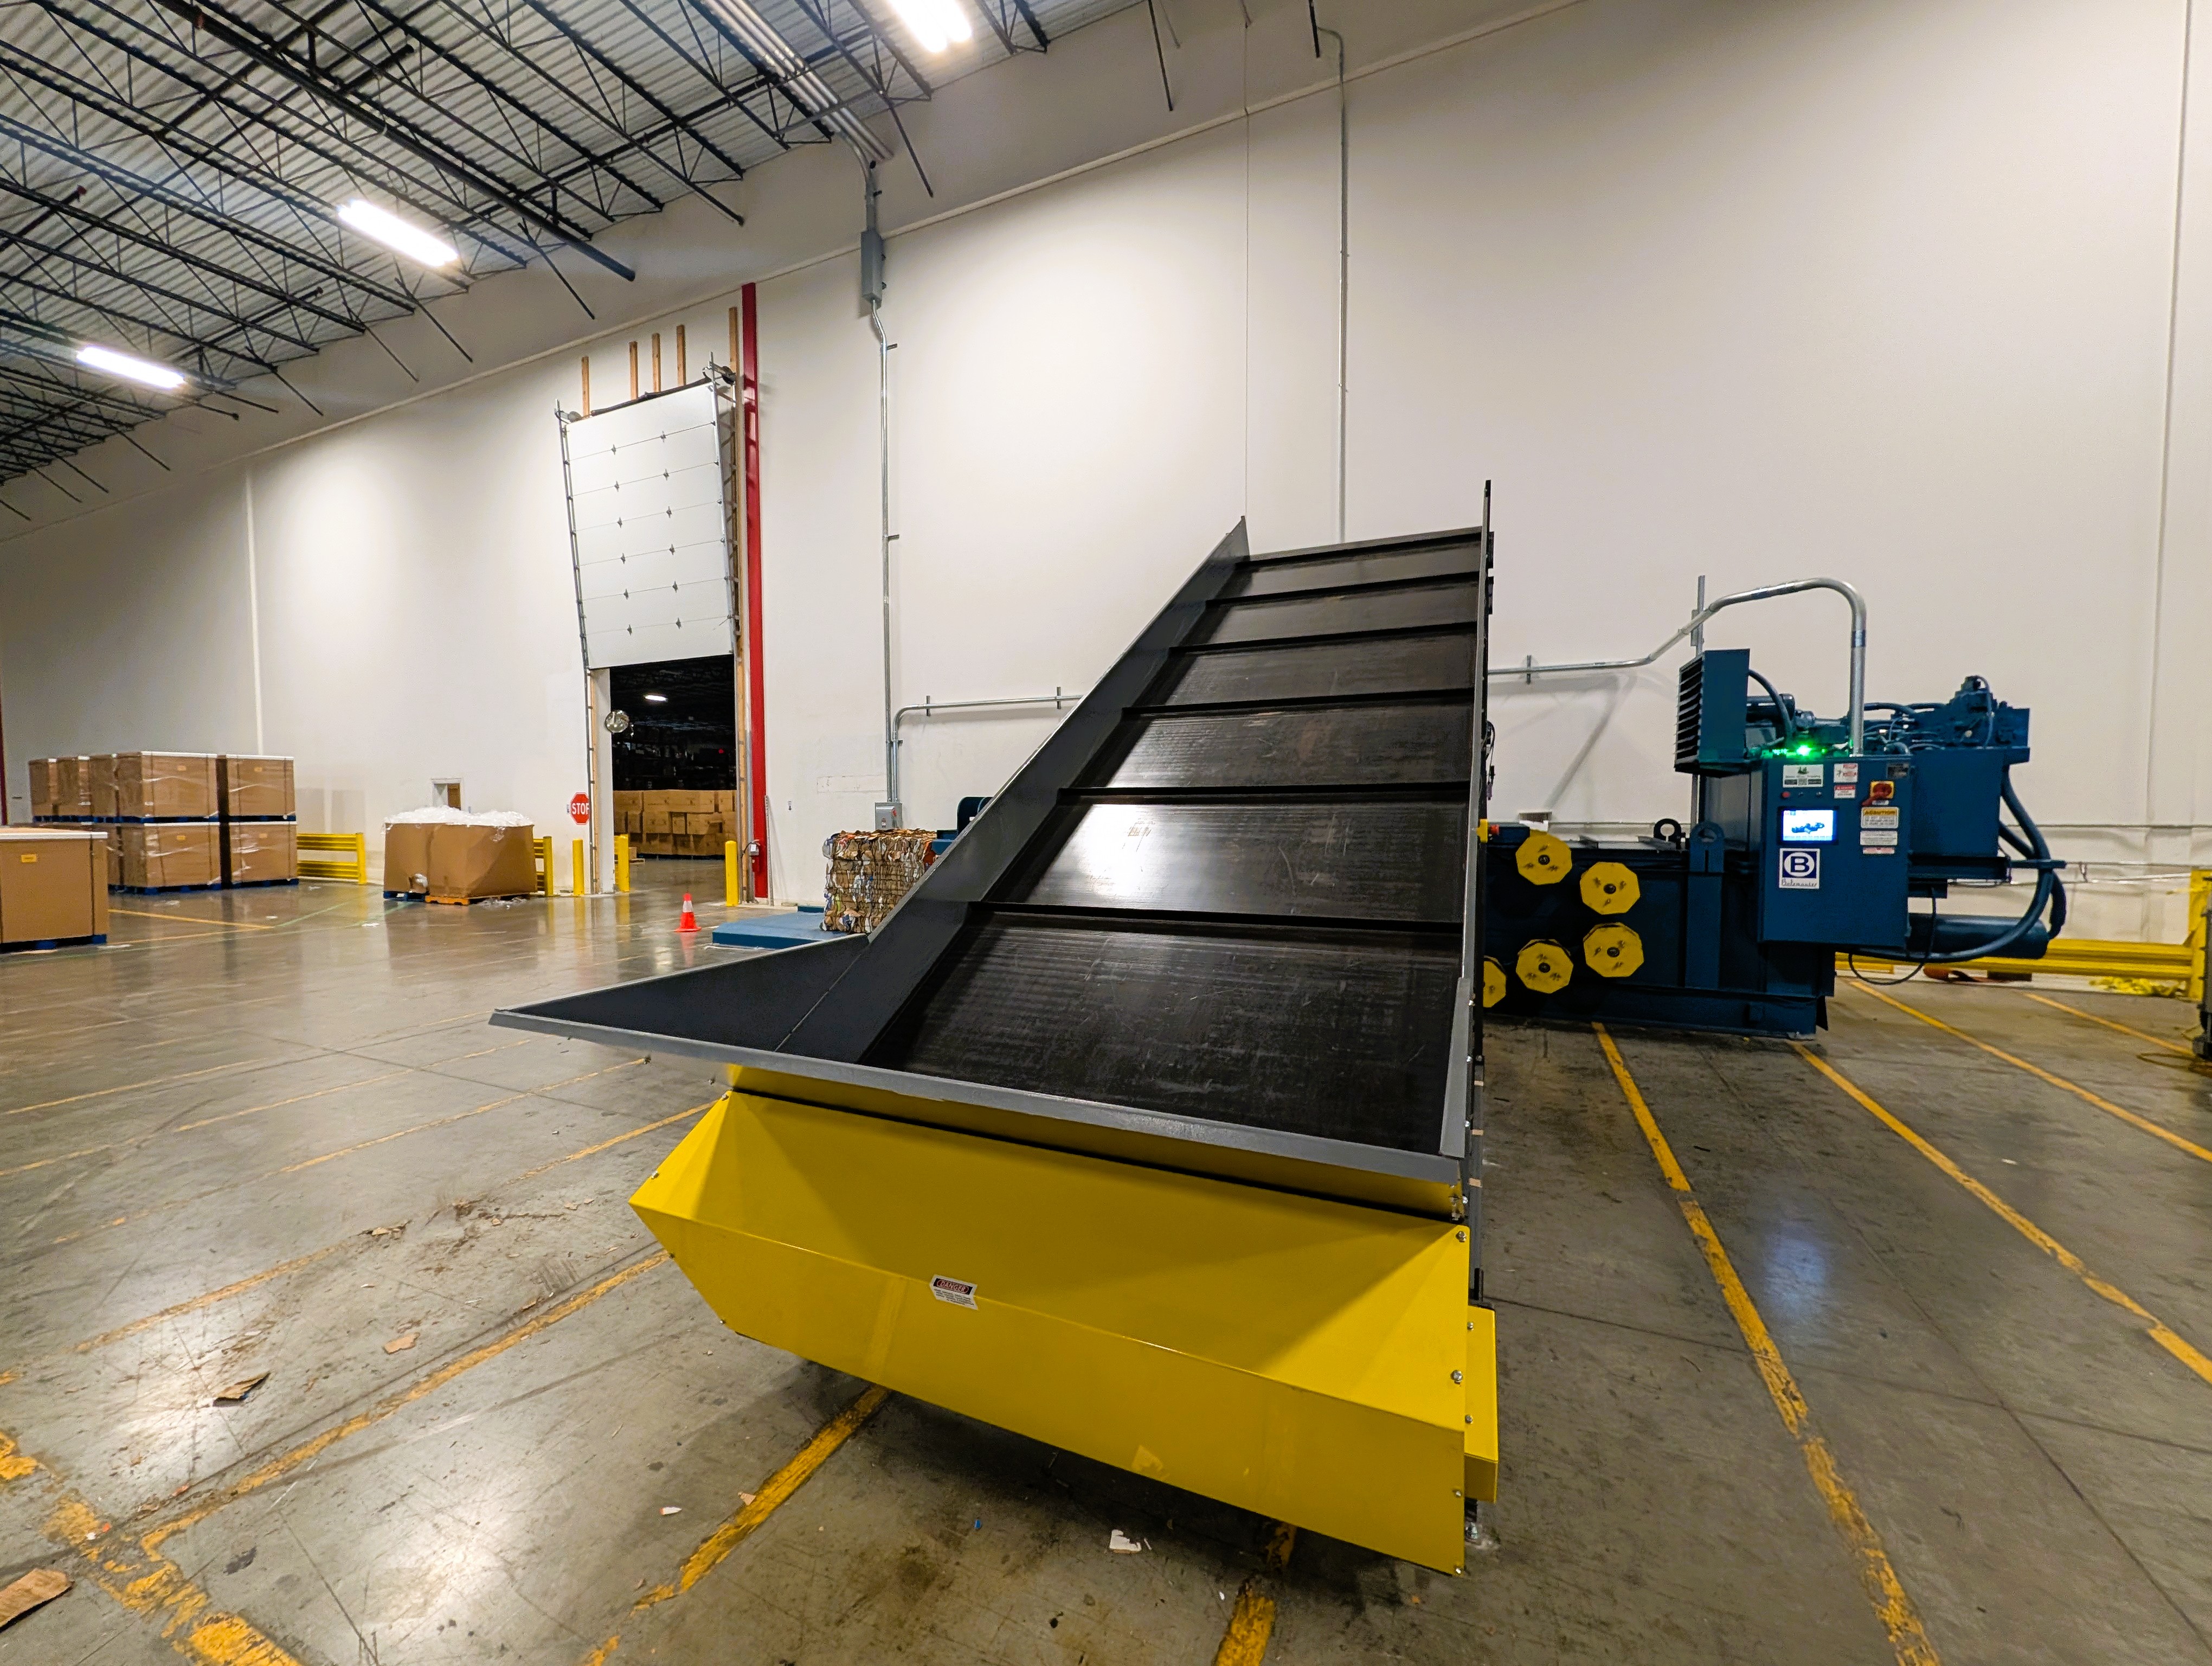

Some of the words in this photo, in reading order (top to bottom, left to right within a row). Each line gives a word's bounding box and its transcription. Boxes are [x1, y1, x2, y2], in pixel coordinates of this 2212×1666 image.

[572, 803, 589, 815] STOP
[1791, 856, 1810, 873] B
[940, 1281, 966, 1292] DANGER
